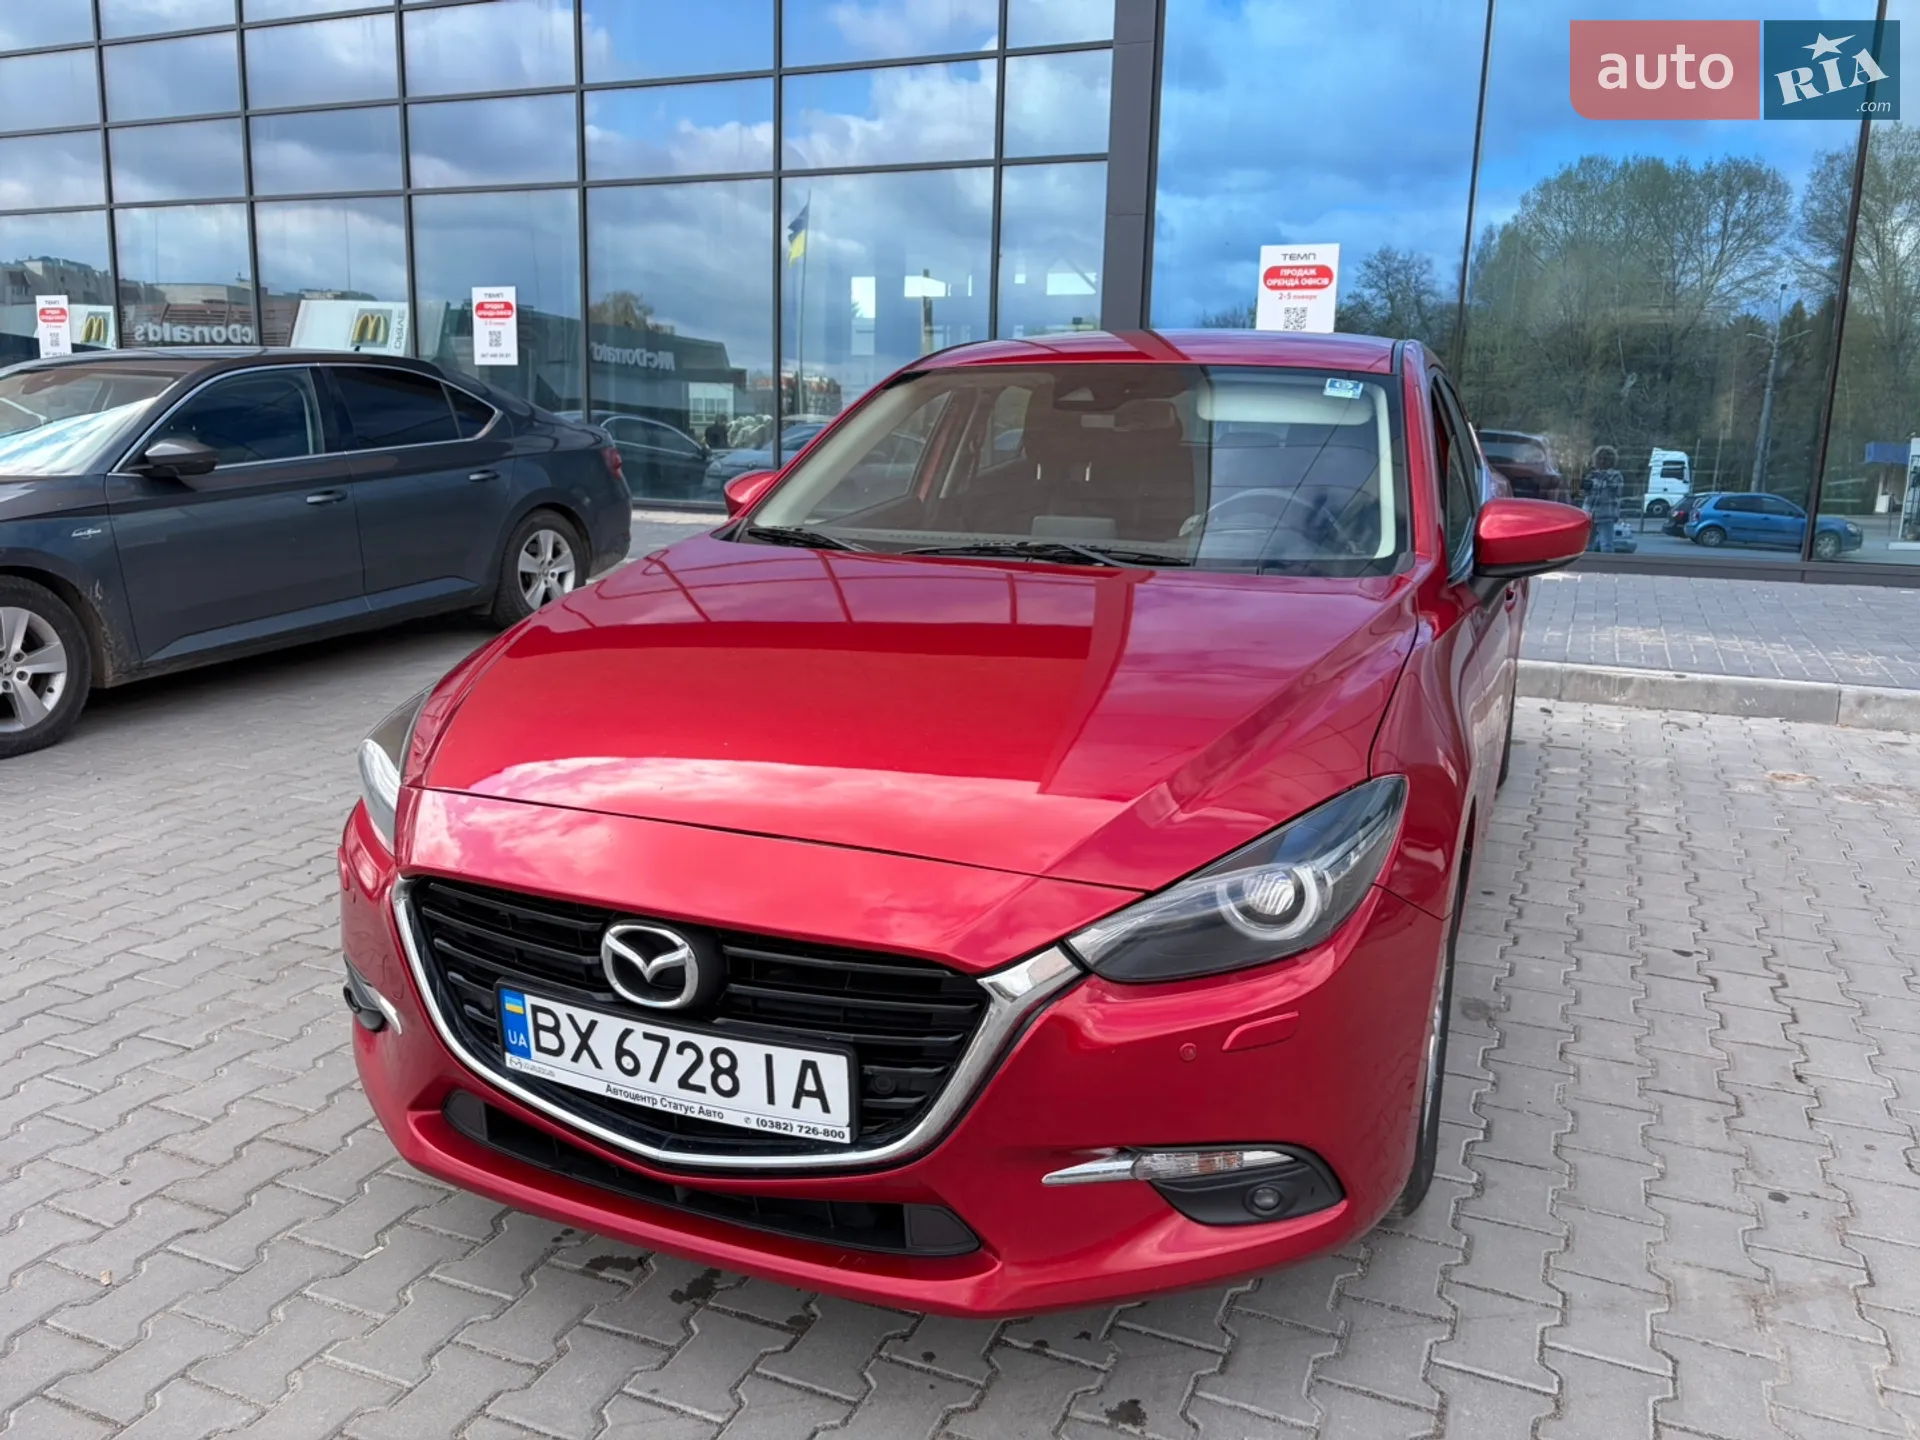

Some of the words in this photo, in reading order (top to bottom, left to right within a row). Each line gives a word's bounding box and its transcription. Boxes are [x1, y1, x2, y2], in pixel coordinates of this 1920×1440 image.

[1281, 252, 1317, 261] ТЕМП
[1266, 278, 1300, 287] ОРЕНДА
[1279, 268, 1317, 277] ПРОДАЖ
[507, 1029, 529, 1049] UA
[530, 1003, 603, 1070] BX
[614, 1027, 741, 1099] 6728
[764, 1053, 831, 1114] IA
[605, 1084, 658, 1107] Автоцентр
[659, 1097, 696, 1115] Статус
[697, 1105, 725, 1120] Авто
[755, 1117, 794, 1133] (0382)
[796, 1124, 846, 1140] 726-800
